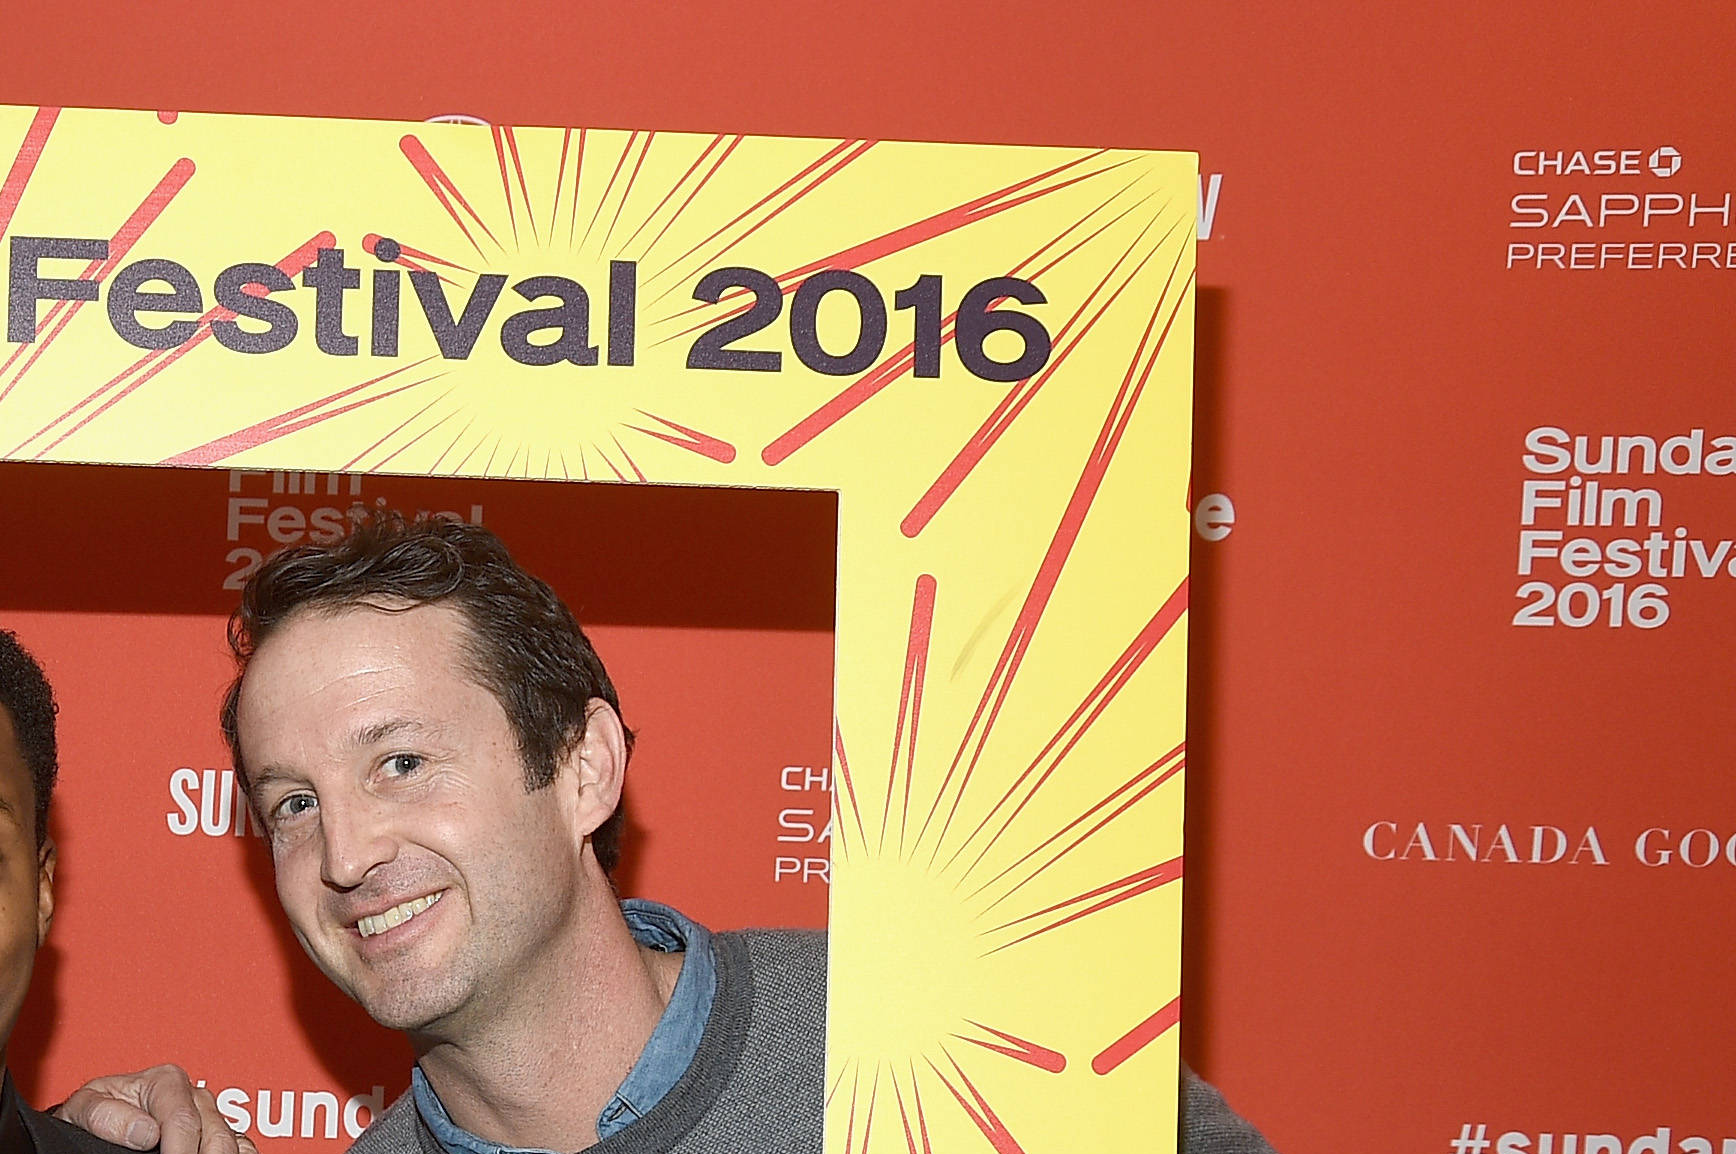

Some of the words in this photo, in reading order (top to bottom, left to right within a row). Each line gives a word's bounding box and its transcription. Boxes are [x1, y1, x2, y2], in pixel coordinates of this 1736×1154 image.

[1512, 150, 1643, 176] CHASE
[1508, 192, 1731, 229] SAPPH
[7, 235, 638, 369] Festival
[684, 265, 1054, 384] 2016
[1520, 476, 1663, 527] Film
[1517, 527, 1736, 578] Festiv
[1510, 580, 1670, 628] 2016
[1363, 821, 1611, 865] CANADA
